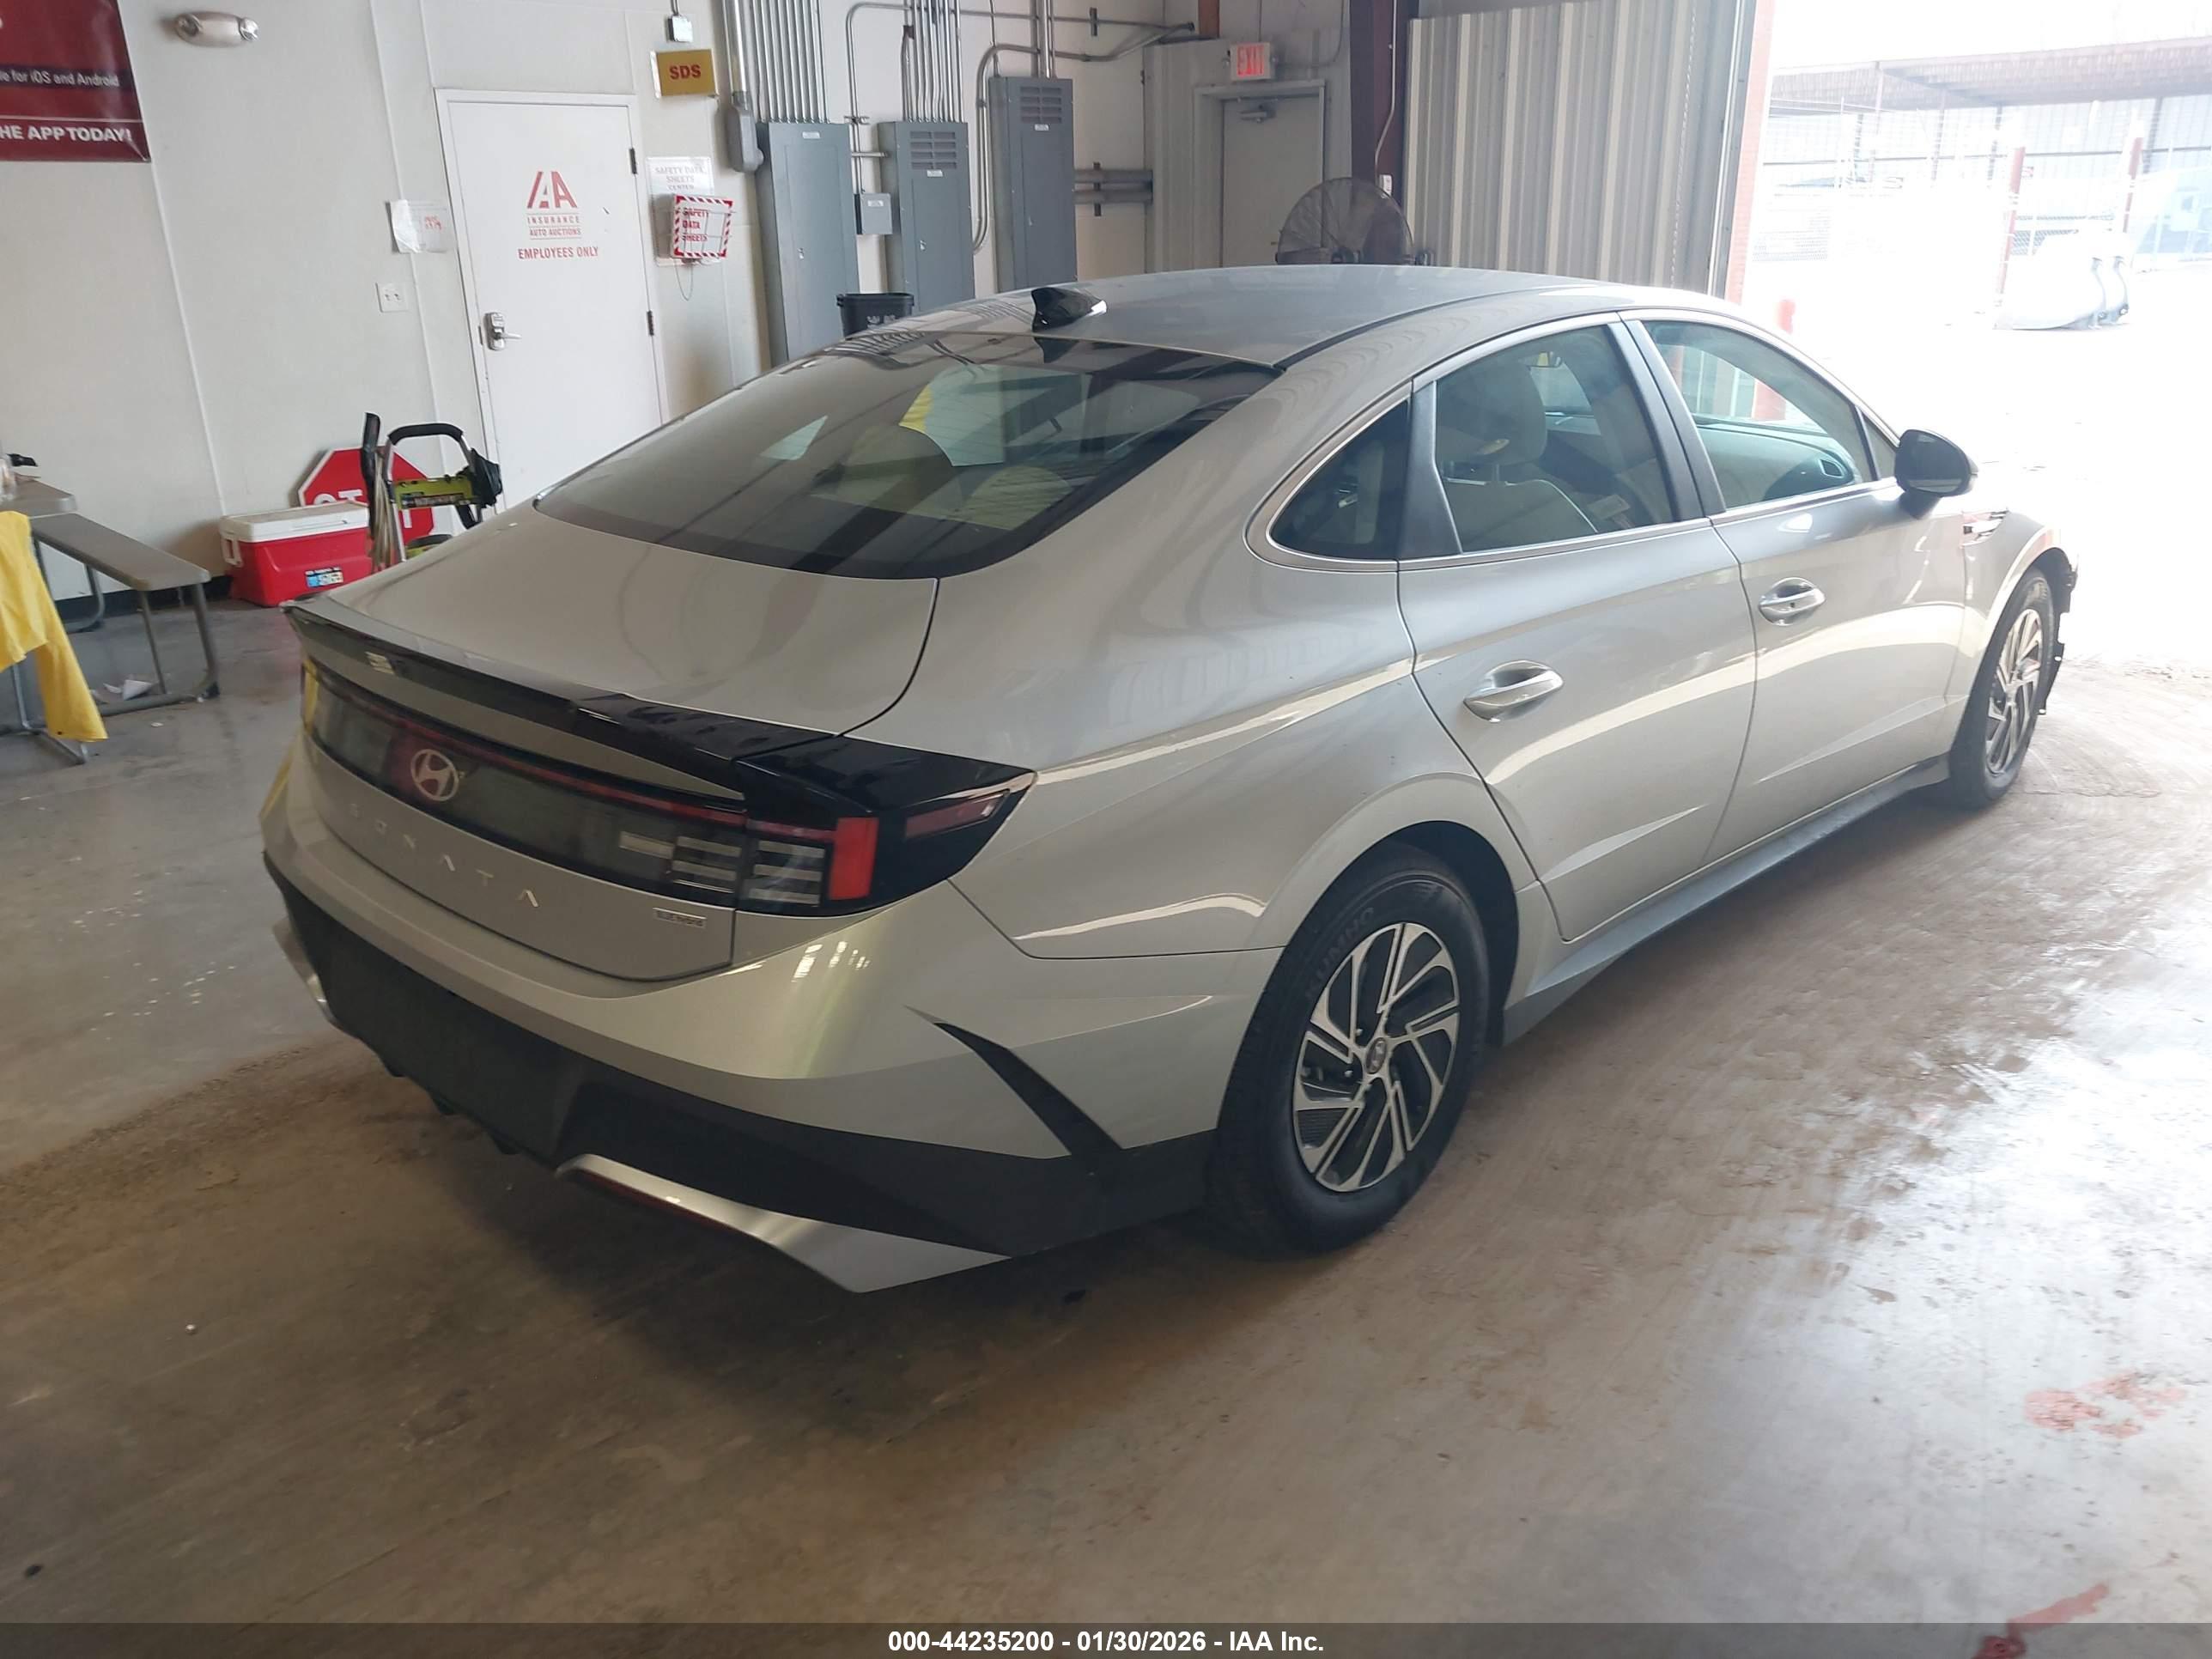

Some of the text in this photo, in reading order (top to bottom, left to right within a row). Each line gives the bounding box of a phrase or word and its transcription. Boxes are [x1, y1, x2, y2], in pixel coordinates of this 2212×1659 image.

[1237, 45, 1265, 76] EXIT
[11, 70, 28, 83] for
[30, 70, 52, 84] iOS
[53, 72, 76, 85] and
[76, 72, 120, 87] Android
[669, 64, 702, 80] SDS
[27, 125, 65, 142] APP
[64, 127, 132, 143] TODAY!
[527, 216, 580, 224] INSURANCE
[529, 228, 582, 237] AUTO AUCTIONS
[517, 246, 599, 259] EMPLOYEES ONLY
[348, 802, 539, 908] SONATA
